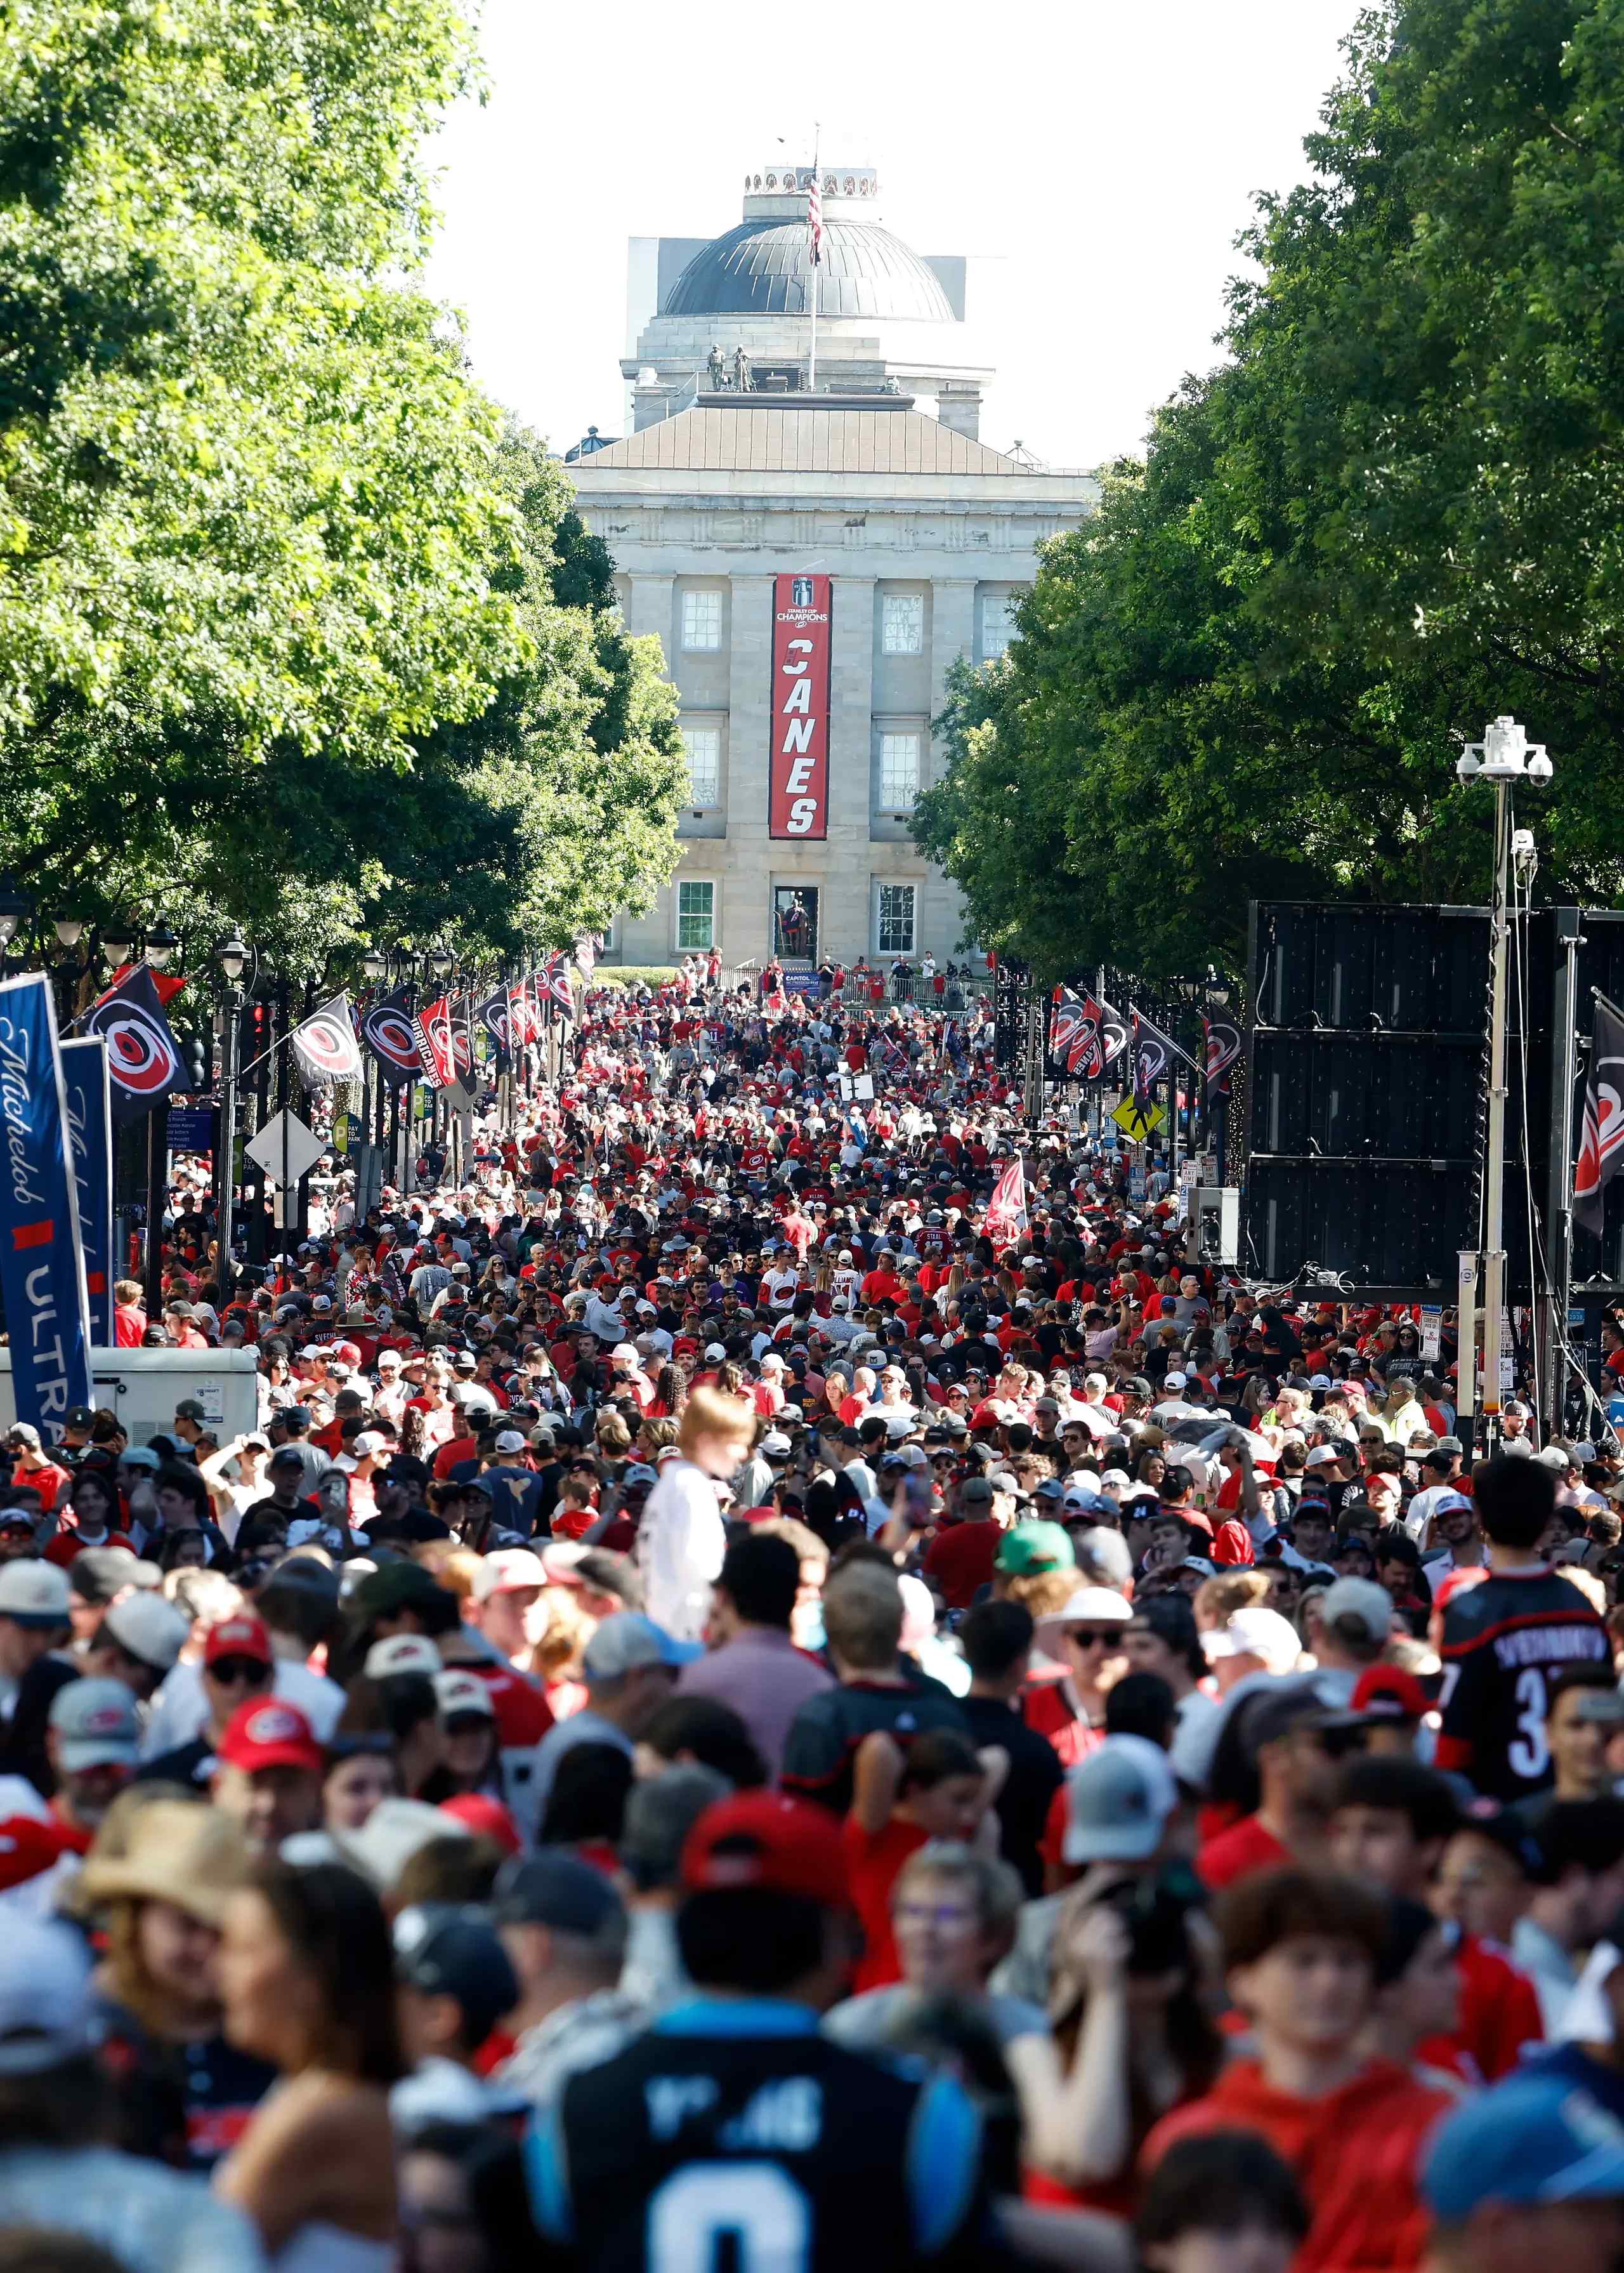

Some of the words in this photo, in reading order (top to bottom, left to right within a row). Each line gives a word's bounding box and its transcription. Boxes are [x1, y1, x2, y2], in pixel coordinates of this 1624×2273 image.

[782, 638, 818, 833] CANES
[0, 1017, 45, 1203] Michelob
[238, 1224, 245, 1234] P
[25, 1264, 68, 1447] ULTRA
